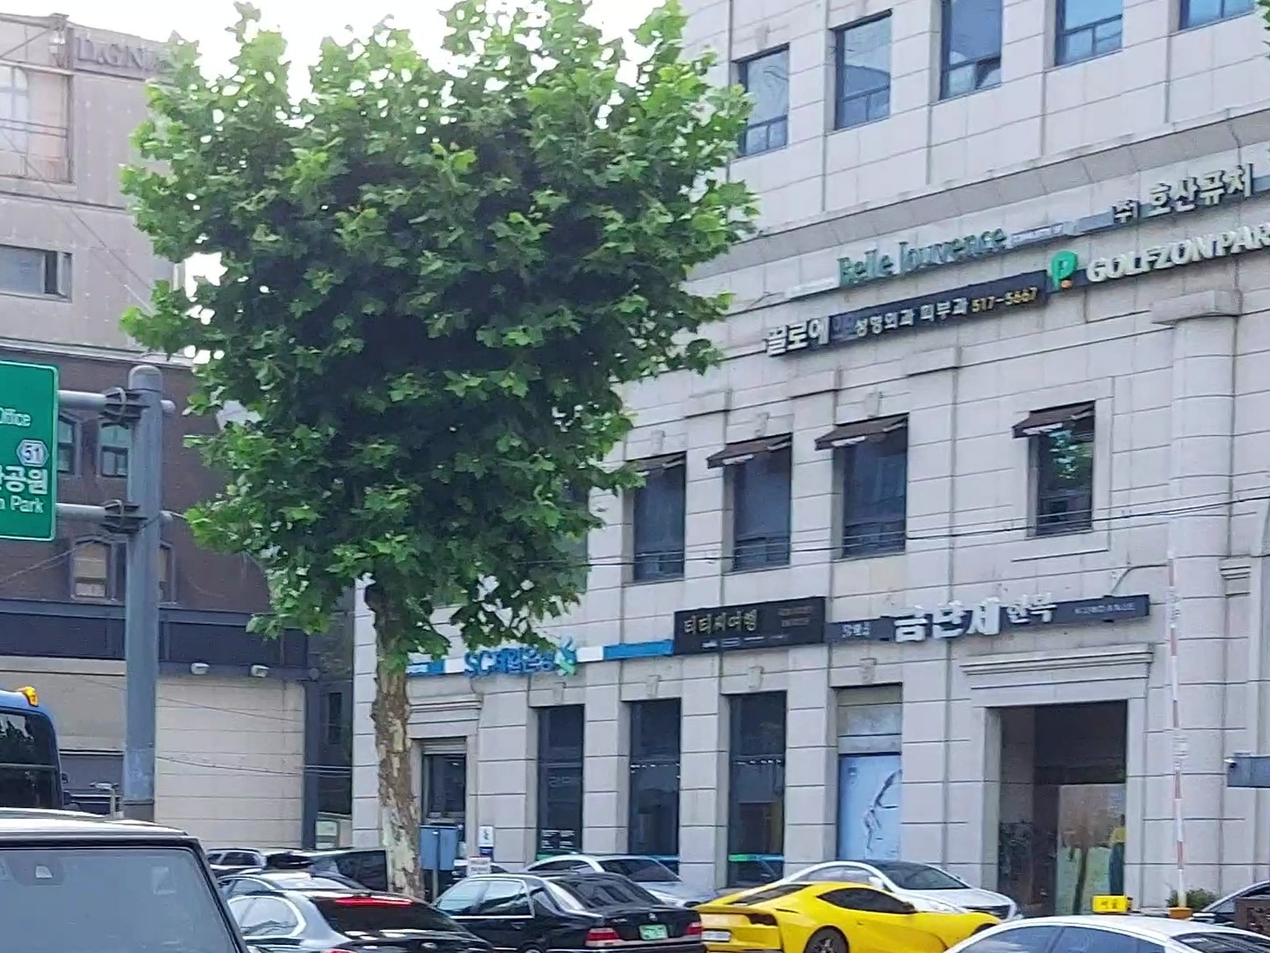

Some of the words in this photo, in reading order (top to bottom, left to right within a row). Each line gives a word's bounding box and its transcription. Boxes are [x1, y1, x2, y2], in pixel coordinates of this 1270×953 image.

[856, 308, 915, 337] 성형외과
[920, 297, 969, 322] 피부과
[22, 444, 44, 464] 51
[10, 495, 44, 514] Park
[1006, 591, 1058, 624] 한복
